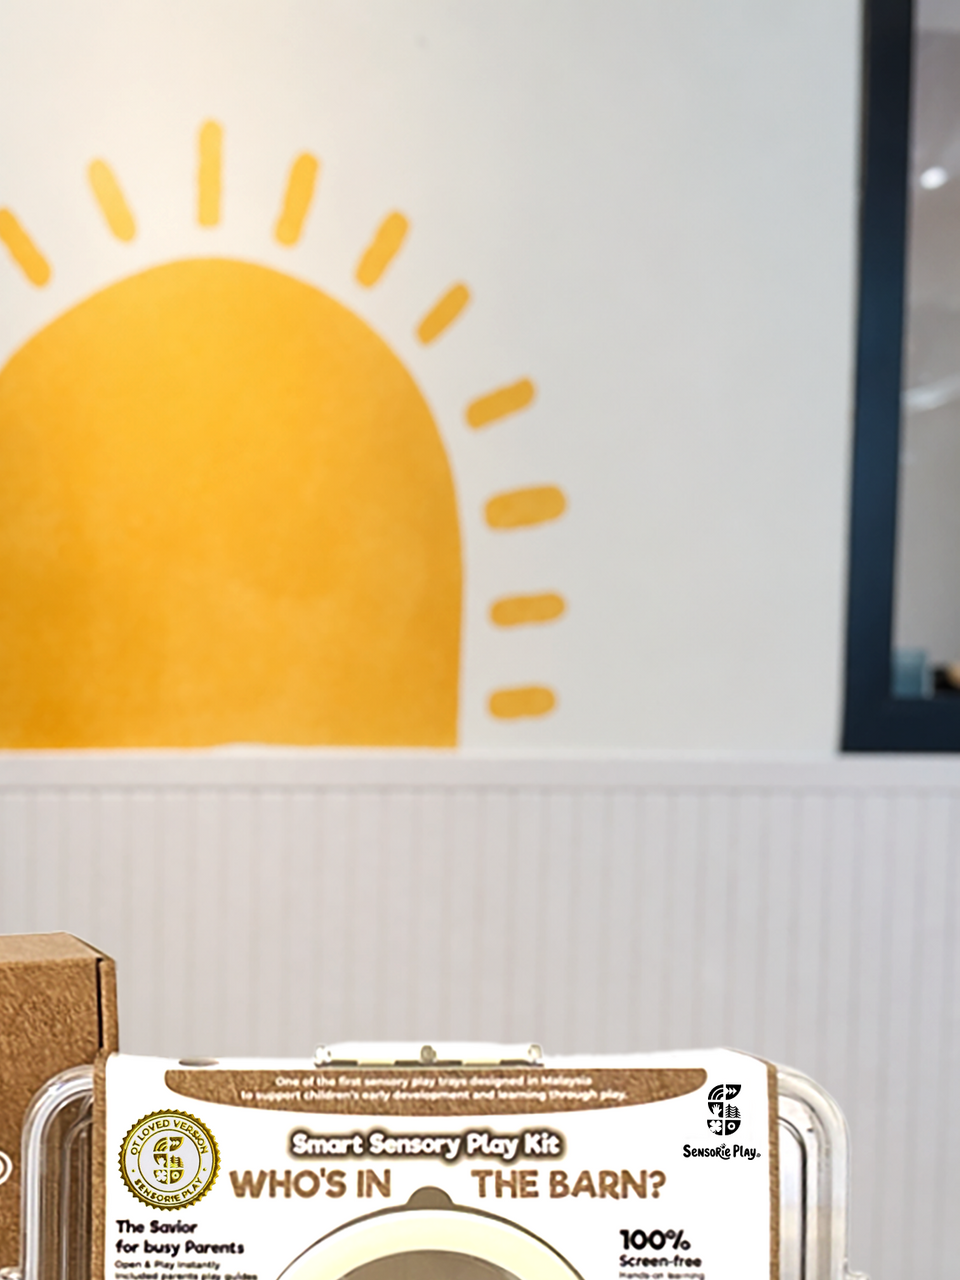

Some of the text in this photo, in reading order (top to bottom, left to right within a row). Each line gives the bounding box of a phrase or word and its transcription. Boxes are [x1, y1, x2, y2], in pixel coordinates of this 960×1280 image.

[275, 1077, 300, 1087] One
[364, 1077, 408, 1089] sensory
[469, 1076, 525, 1088] designed
[541, 1075, 592, 1088] Malaysia
[361, 1090, 391, 1102] early
[130, 1119, 209, 1155] OT LOVED VERSION
[292, 1132, 561, 1159] Smart Sensory Play Kit
[134, 1177, 203, 1202] SENSORIE PLAY
[229, 1167, 667, 1200] WHO'S IN THE BARN?
[116, 1219, 198, 1234] The Savior
[115, 1239, 245, 1258] for busy Parents
[619, 1229, 691, 1250] 100%
[114, 1259, 142, 1270] Open
[154, 1259, 175, 1270] Play
[619, 1254, 702, 1267] Screen-free
